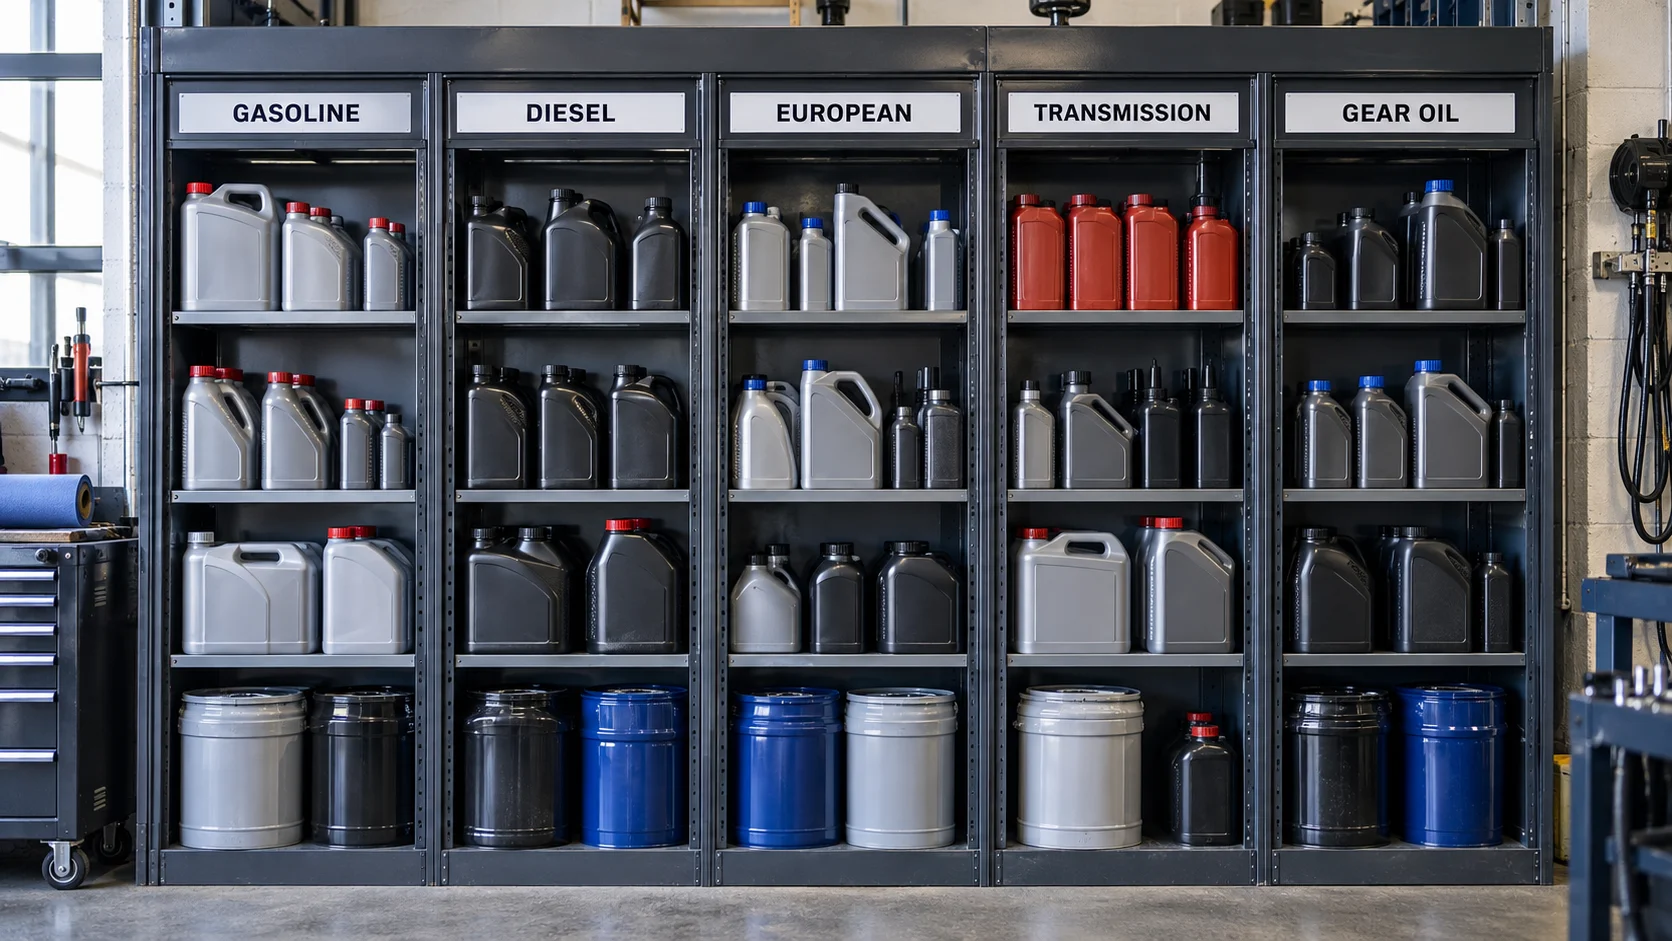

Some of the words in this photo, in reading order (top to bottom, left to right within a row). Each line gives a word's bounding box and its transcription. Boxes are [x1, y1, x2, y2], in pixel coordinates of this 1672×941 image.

[233, 103, 360, 123] GASOLINE
[526, 103, 616, 123] DIESEL
[777, 103, 912, 123] EUROPEAN
[1033, 103, 1211, 122] TRANSMISSION
[1342, 103, 1411, 123] GEAR
[1419, 103, 1460, 123] OIL
